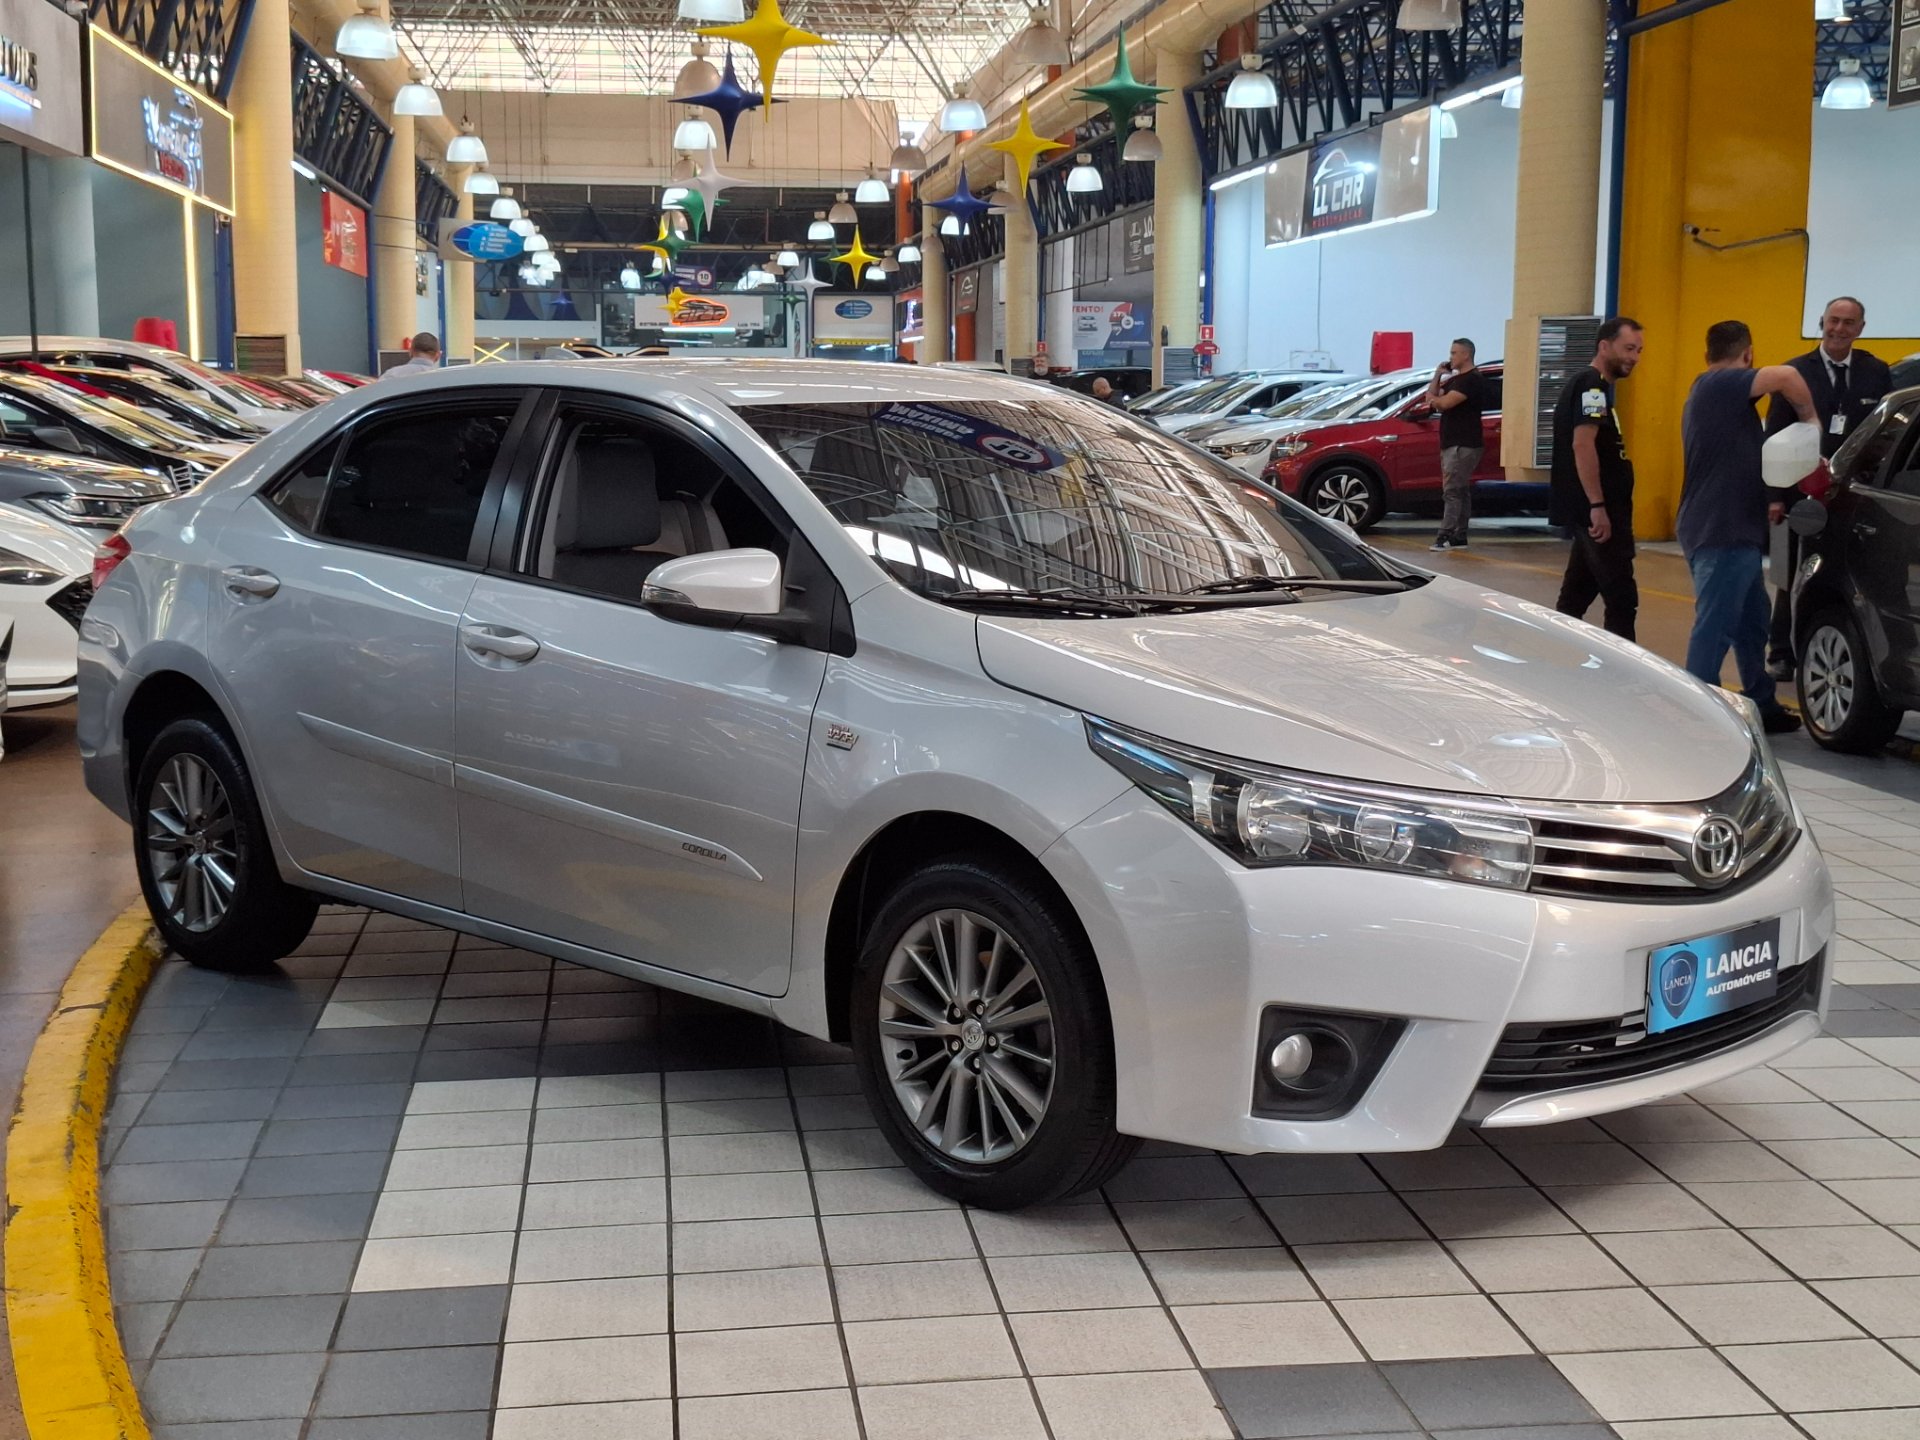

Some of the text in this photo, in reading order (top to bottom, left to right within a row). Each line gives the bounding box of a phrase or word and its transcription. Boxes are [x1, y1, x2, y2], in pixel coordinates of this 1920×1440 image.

[1331, 172, 1365, 212] CAR
[681, 842, 728, 861] COROLLA
[1706, 940, 1772, 979] LANCIA
[1663, 974, 1693, 991] LANCIA
[1705, 968, 1772, 997] AUTOMÓVEIS
